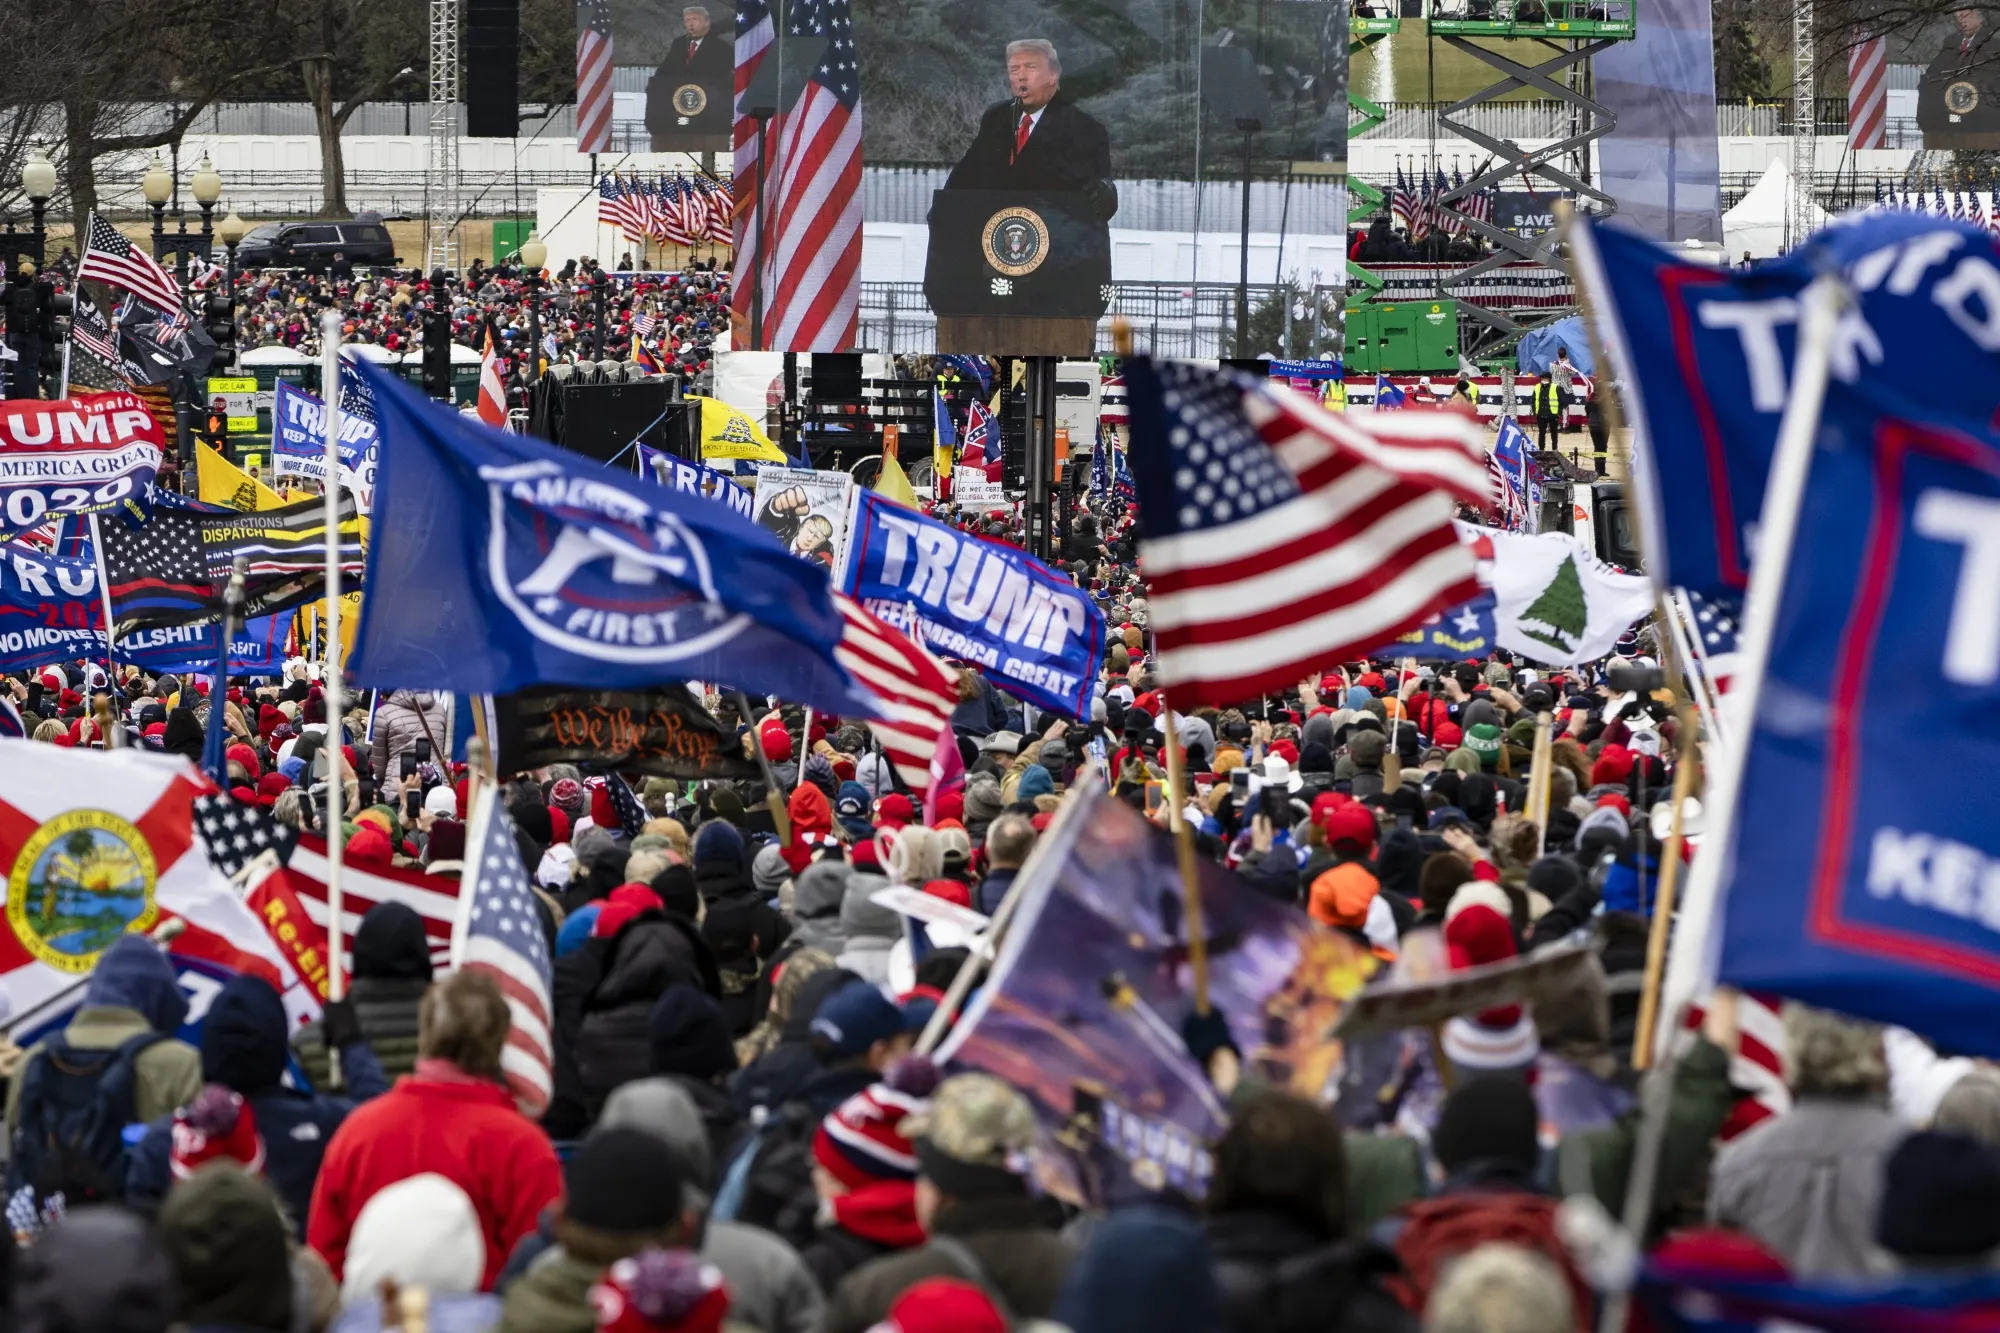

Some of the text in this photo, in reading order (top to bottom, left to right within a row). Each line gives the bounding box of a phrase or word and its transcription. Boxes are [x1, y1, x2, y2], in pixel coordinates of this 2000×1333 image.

[985, 209, 1014, 241] PRESIDENT
[1033, 218, 1048, 246] UNITED
[1514, 214, 1554, 226] SAVE
[72, 396, 134, 413] Donald
[0, 409, 153, 447] UMP
[283, 428, 306, 443] KEEP
[0, 446, 157, 477] MERICA GREAT
[0, 475, 133, 528] 020
[650, 458, 753, 520] TRUM
[44, 497, 147, 523] The United States
[202, 528, 264, 544] DISPATCH
[878, 511, 1086, 656] TRUMP
[25, 626, 95, 649] MORE
[95, 623, 206, 651] BLLSHIT
[566, 606, 680, 646] FIRST
[228, 641, 261, 657] REAT!
[920, 614, 999, 670] MERICA
[1002, 656, 1078, 697] GREAT
[551, 706, 603, 750] We
[263, 896, 330, 999] Re-Ele
